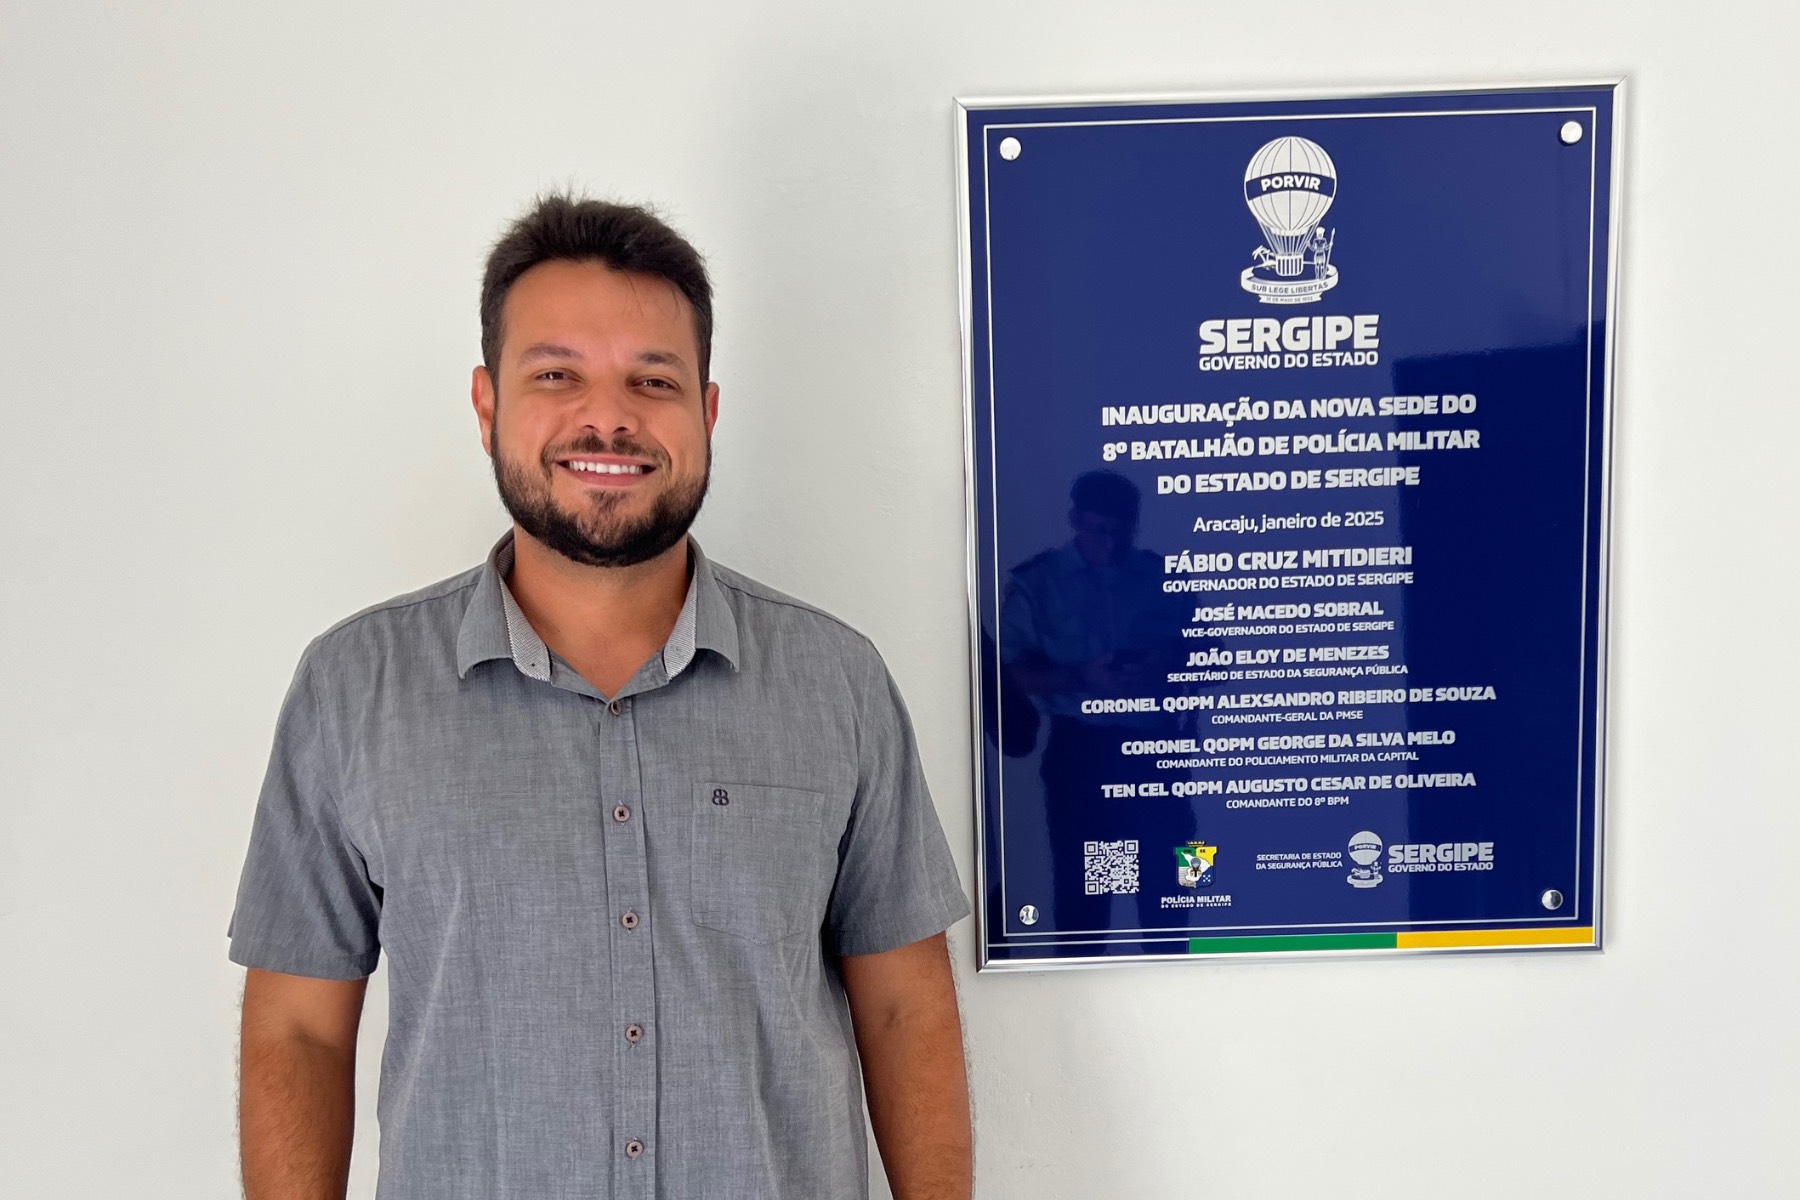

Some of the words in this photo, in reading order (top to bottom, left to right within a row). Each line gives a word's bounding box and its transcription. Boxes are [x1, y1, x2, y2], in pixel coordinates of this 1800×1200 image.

[1261, 175, 1321, 191] PORVIR
[1251, 284, 1267, 292] SUB
[1291, 282, 1329, 294] LIBERTAS
[1199, 315, 1379, 354] SERGIPE
[1199, 354, 1280, 371] GOVERNO
[1284, 353, 1308, 368] DO
[1312, 351, 1378, 367] ESTADO
[1102, 396, 1269, 427] INAUGURAÇÃO
[1273, 400, 1307, 419] DA
[1311, 397, 1375, 418] NOVA
[1378, 395, 1439, 416] SEDE
[1442, 394, 1476, 414] DO
[1131, 433, 1254, 460] BATALHÃO
[1258, 436, 1289, 455] DE
[1293, 429, 1383, 454] POLÍCIA
[1387, 430, 1480, 451] MILITAR
[1158, 474, 1191, 494] DO
[1195, 471, 1287, 493] ESTADO
[1291, 470, 1321, 489] DE
[1324, 466, 1420, 488] SERGIPE
[1193, 514, 1258, 534] Aracaju,
[1259, 513, 1317, 533] janeiro
[1321, 512, 1341, 527] de
[1344, 511, 1384, 526] 2025
[1165, 550, 1233, 574] FÁBIO
[1238, 551, 1298, 570] CRUZ
[1303, 547, 1412, 568] MITIDIERI
[1163, 577, 1257, 592] GOVERNADOR
[1259, 576, 1279, 589] DO
[1281, 574, 1335, 588] ESTADO
[1337, 574, 1355, 586] DE
[1357, 572, 1414, 586] SERGIPE
[1192, 603, 1235, 622] JOSÉ
[1238, 603, 1311, 620] MACEDO
[1313, 601, 1384, 617] SOBRAL
[1182, 625, 1277, 638] VICE-GOVERNADOR
[1279, 624, 1294, 634] DO
[1295, 623, 1335, 633] ESTADO
[1337, 622, 1351, 632] DE
[1352, 621, 1394, 631] SERGIPE
[1186, 648, 1233, 667] JOÃO
[1236, 649, 1281, 664] ELOY
[1283, 648, 1307, 663] DE
[1309, 645, 1389, 662] MENEZES
[1167, 670, 1228, 682] SECRETÁRIO
[1230, 671, 1244, 680] DE
[1245, 669, 1285, 679] ESTADO
[1287, 669, 1302, 678] DA
[1303, 666, 1364, 678] SEGURANÇA
[1365, 664, 1408, 675] PÚBLICA
[1081, 698, 1161, 714] CORONEL
[1163, 695, 1214, 713] QOPM
[1217, 691, 1335, 709] ALEXSANDRO
[1338, 689, 1406, 705] RIBEIRO
[1409, 688, 1433, 702] DE
[1435, 686, 1496, 701] SOUZA
[1212, 712, 1318, 724] COMANDANTE-GERAL
[1319, 711, 1334, 720] DA
[1336, 710, 1363, 720] PMSE
[1121, 739, 1201, 755] CORONEL
[1203, 737, 1254, 754] QOPM
[1257, 735, 1326, 750] GEORGE
[1328, 734, 1354, 748] DA
[1356, 732, 1405, 747] SILVA
[1407, 730, 1455, 745] MELO
[1156, 758, 1226, 769] COMANDANTE
[1228, 757, 1243, 766] DO
[1245, 755, 1318, 766] POLICIAMENTO
[1320, 753, 1359, 763] MILITAR
[1361, 753, 1376, 762] DA
[1377, 751, 1419, 761] CAPITAL
[1101, 784, 1135, 798] TEN
[1138, 783, 1169, 797] CEL
[1172, 780, 1223, 797] QOPM
[1225, 778, 1308, 794] AUGUSTO
[1311, 776, 1366, 791] CESAR
[1369, 775, 1392, 789] DE
[1395, 773, 1476, 789] OLIVEIRA
[1226, 798, 1296, 809] COMANDANTE
[1298, 797, 1313, 806] DO
[1327, 796, 1349, 805] BPM
[1257, 853, 1300, 861] SECRETARIA
[1388, 842, 1494, 864] SERGIPE
[1267, 861, 1311, 870] SEGURANÇA
[1312, 860, 1343, 868] PÚBLICA
[1388, 863, 1436, 873] GOVERNO
[1437, 863, 1452, 871] DO
[1454, 862, 1493, 871] ESTADO
[1161, 895, 1195, 904] POLÍCIA
[1197, 895, 1231, 903] MILITAR
